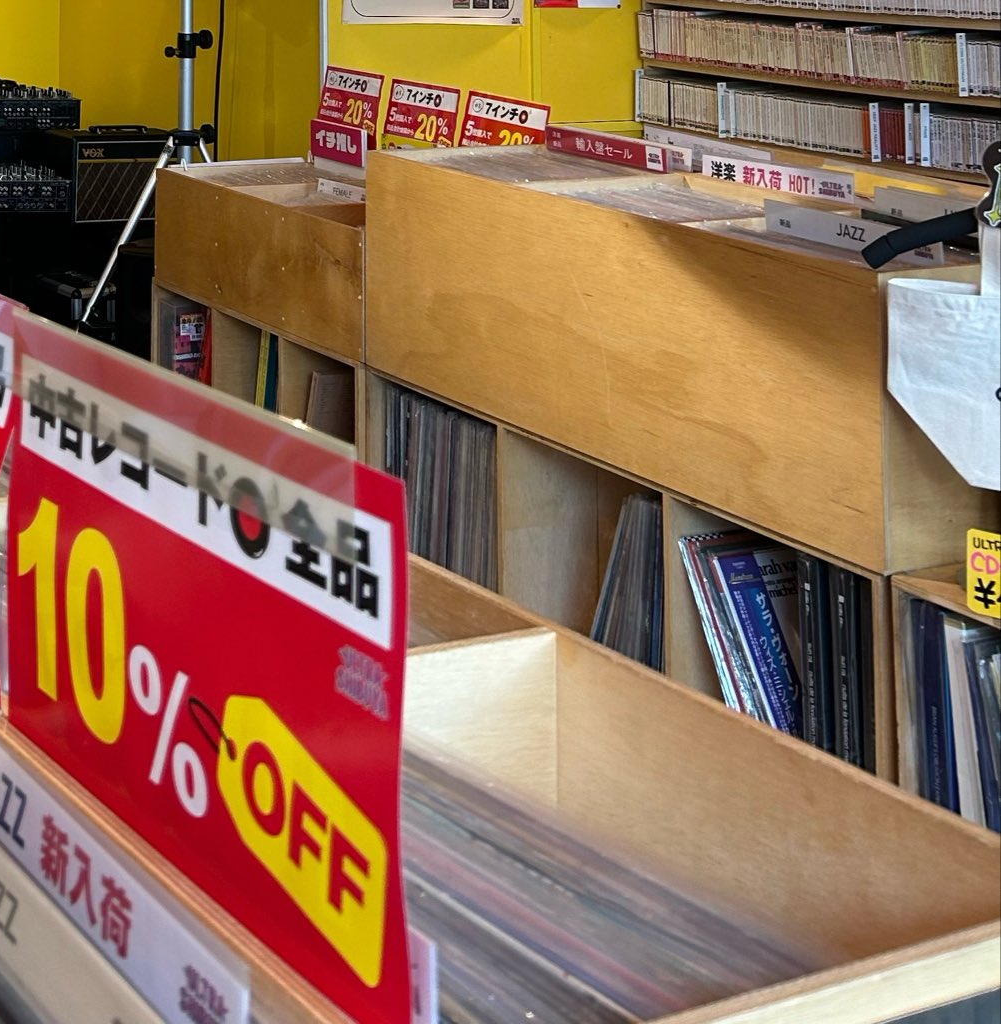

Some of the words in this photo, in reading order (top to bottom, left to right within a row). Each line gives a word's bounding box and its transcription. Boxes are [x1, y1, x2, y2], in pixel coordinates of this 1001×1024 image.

[339, 76, 361, 90] 7インチ
[407, 89, 434, 105] 7インチ
[343, 98, 372, 125] 20%
[485, 102, 519, 121] 7インチ
[414, 113, 448, 142] 20%
[315, 129, 357, 154] イチ推し
[575, 137, 633, 160] 輸入盤セール
[82, 148, 105, 158] VOX
[711, 160, 736, 182] 洋楽
[743, 165, 782, 191] 新入荷
[789, 174, 815, 195] HOT!
[333, 187, 352, 199] FEMALE
[836, 223, 867, 243] JAZZ
[973, 537, 1001, 551] ULTR
[17, 495, 208, 819] 10%
[241, 739, 371, 916] OFF
[39, 813, 134, 960] 新入荷
